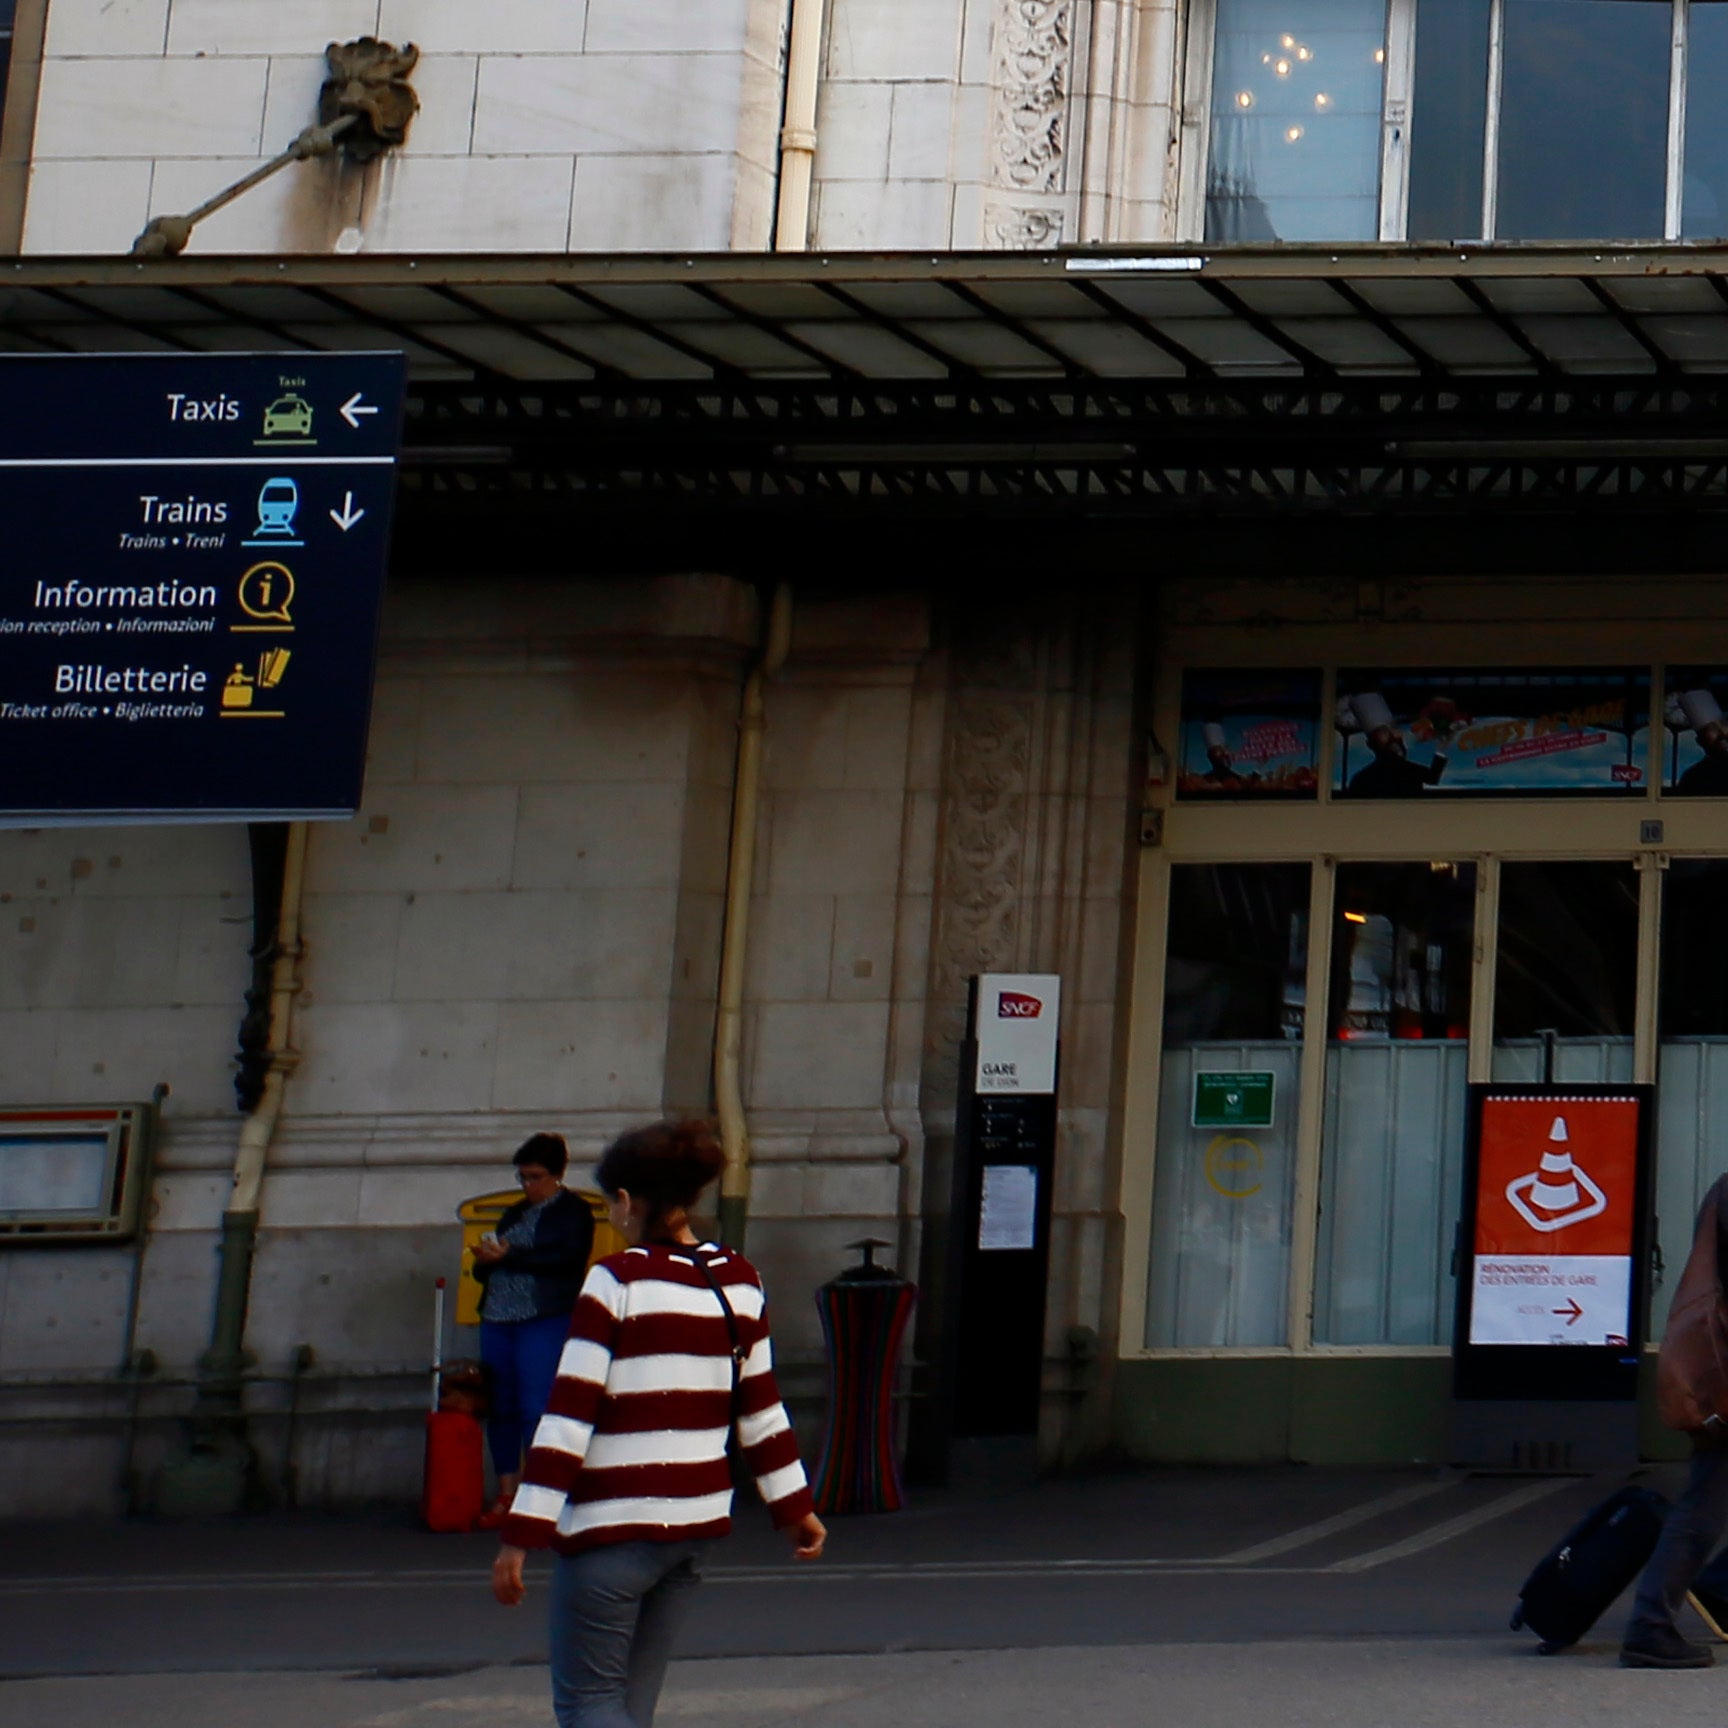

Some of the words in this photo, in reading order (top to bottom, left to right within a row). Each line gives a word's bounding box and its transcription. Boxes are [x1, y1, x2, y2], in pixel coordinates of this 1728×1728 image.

[167, 393, 239, 421] Taxis
[140, 495, 227, 523] Trains
[119, 533, 166, 548] Trains
[185, 532, 226, 548] Treni
[35, 579, 216, 607] Information
[27, 618, 100, 636] reception
[116, 617, 216, 633] Informazioni
[55, 664, 207, 693] Billetterie
[1, 702, 48, 719] Ticket
[51, 701, 98, 719] office
[115, 701, 204, 722] Biglietteria
[1000, 1001, 1040, 1016] SNCF
[982, 1062, 1016, 1075] GARE
